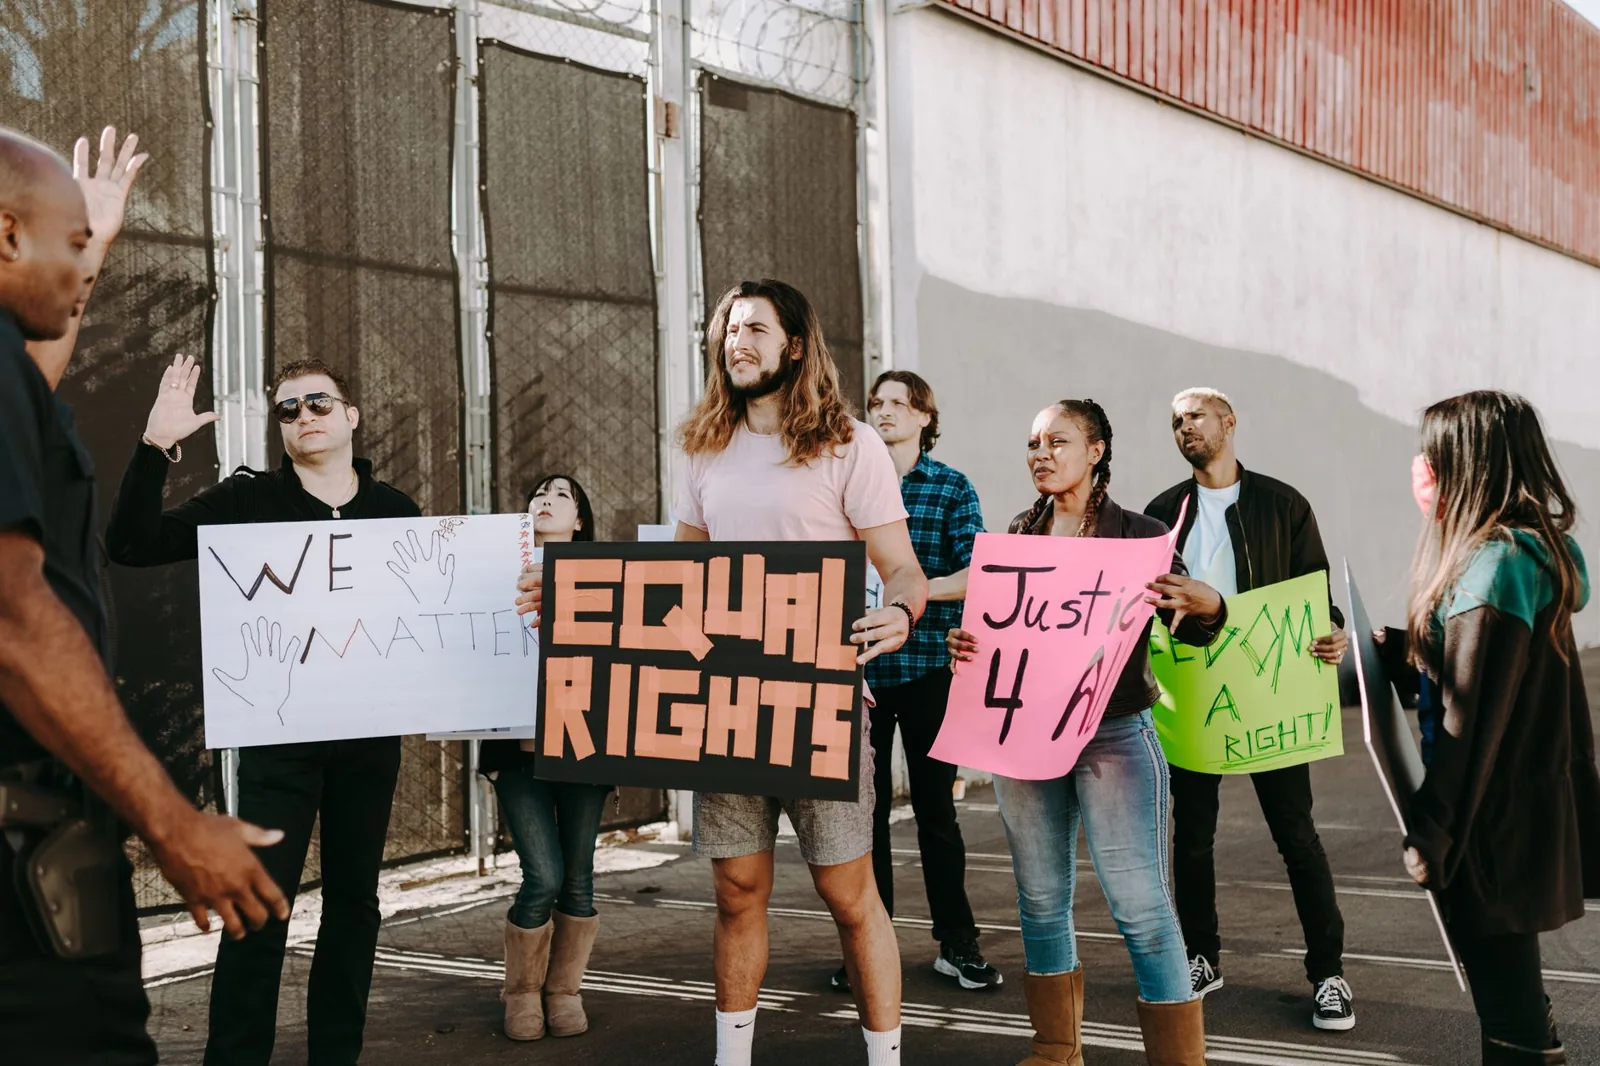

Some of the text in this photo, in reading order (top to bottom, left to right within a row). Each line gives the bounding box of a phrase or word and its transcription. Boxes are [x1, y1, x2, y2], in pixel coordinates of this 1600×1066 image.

[208, 533, 353, 601] WE
[981, 564, 1146, 636] Justic
[553, 554, 858, 671] EQUAL
[543, 656, 855, 780] RIGHTS
[984, 648, 1029, 745] 4
[1204, 684, 1241, 727] A
[1224, 703, 1333, 761] RIGHT!
